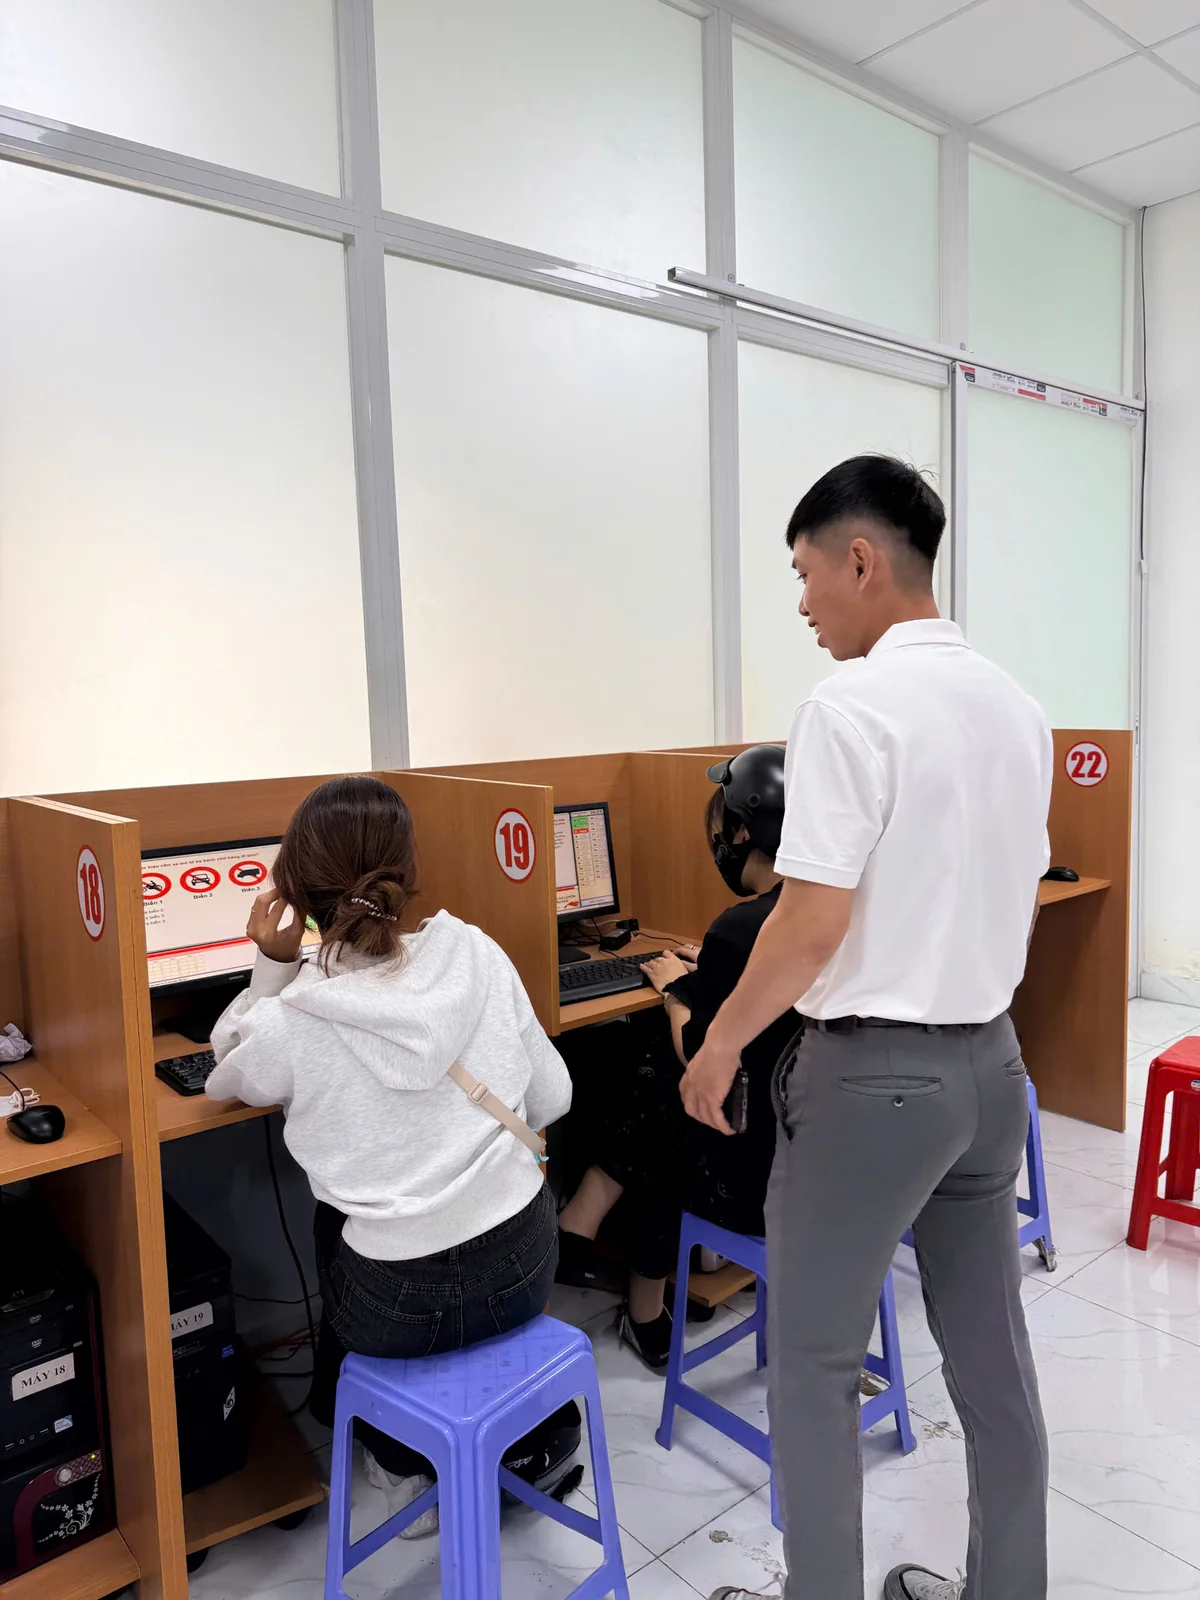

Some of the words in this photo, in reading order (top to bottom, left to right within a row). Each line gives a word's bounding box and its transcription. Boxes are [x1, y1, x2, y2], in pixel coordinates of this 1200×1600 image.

[1071, 751, 1102, 778] 22
[499, 822, 530, 870] 19
[80, 862, 102, 925] 18
[194, 1312, 204, 1323] 19
[21, 1370, 50, 1389] MÁY
[54, 1364, 66, 1376] 18
